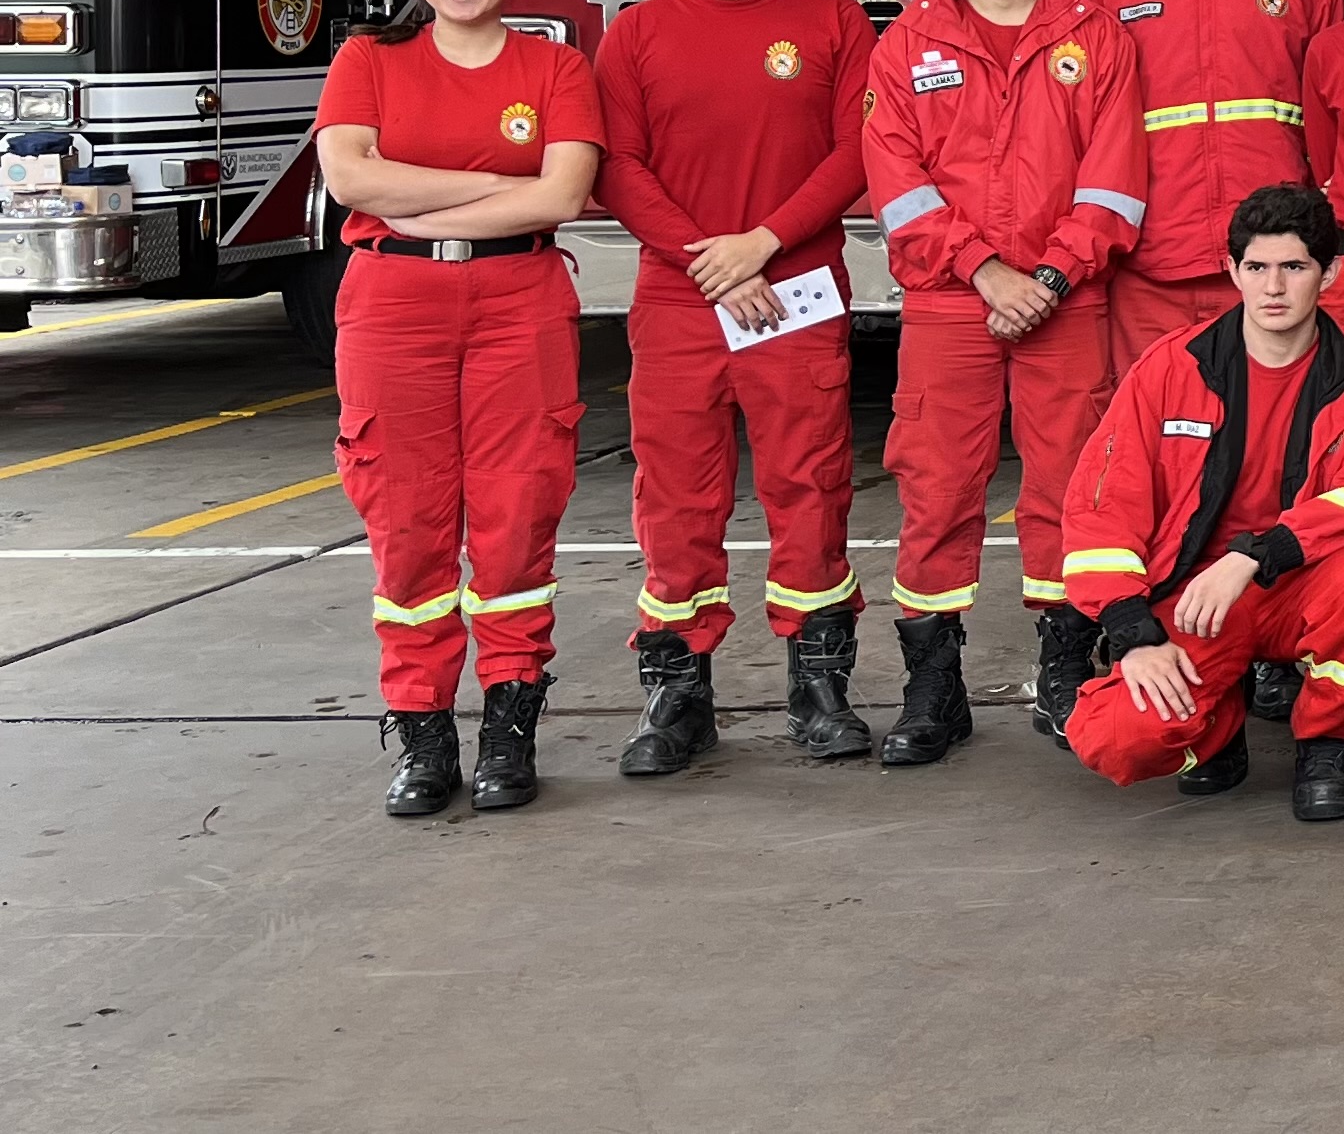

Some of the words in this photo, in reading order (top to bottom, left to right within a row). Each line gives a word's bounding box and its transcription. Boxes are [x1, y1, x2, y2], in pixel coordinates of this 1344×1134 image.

[280, 39, 301, 50] PERU
[931, 74, 956, 86] LAMAS
[239, 152, 282, 163] MUNICIPALIDAD
[239, 165, 247, 173] DE
[248, 162, 281, 172] MIRAFLORES
